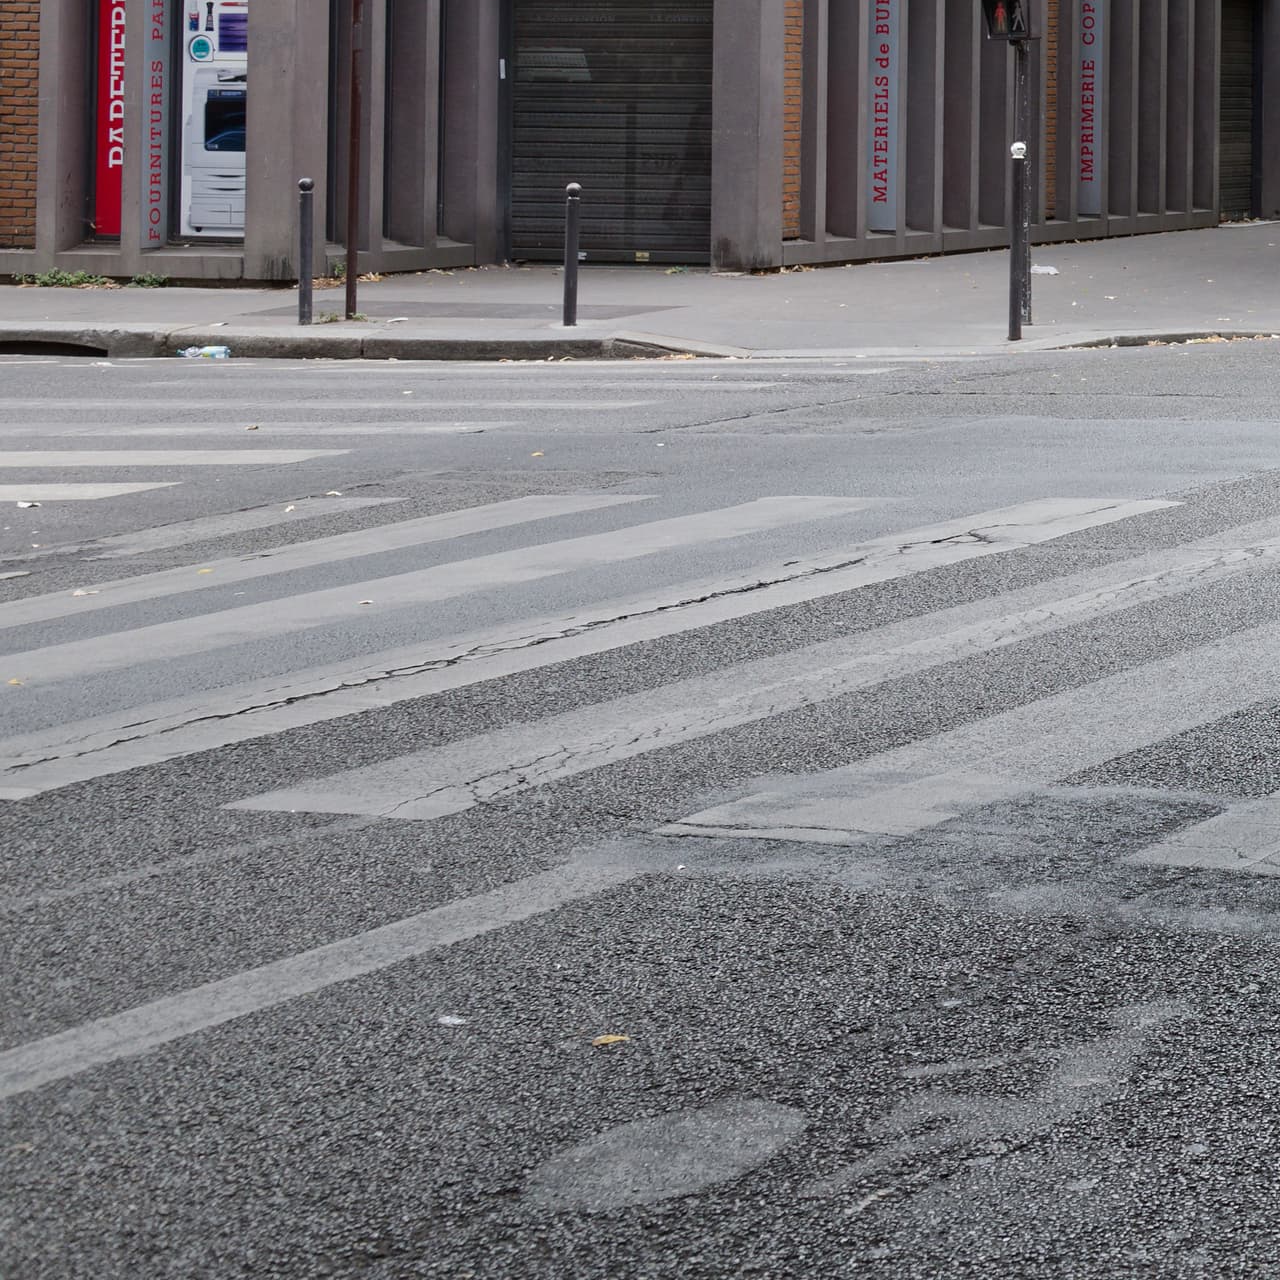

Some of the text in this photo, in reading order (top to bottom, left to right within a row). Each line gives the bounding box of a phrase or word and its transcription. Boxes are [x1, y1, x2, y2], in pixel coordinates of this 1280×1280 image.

[874, 43, 890, 69] de
[148, 60, 164, 241] FOURNITURES
[873, 75, 889, 203] MATERIELS
[1080, 59, 1095, 182] IMPRIMERIE
